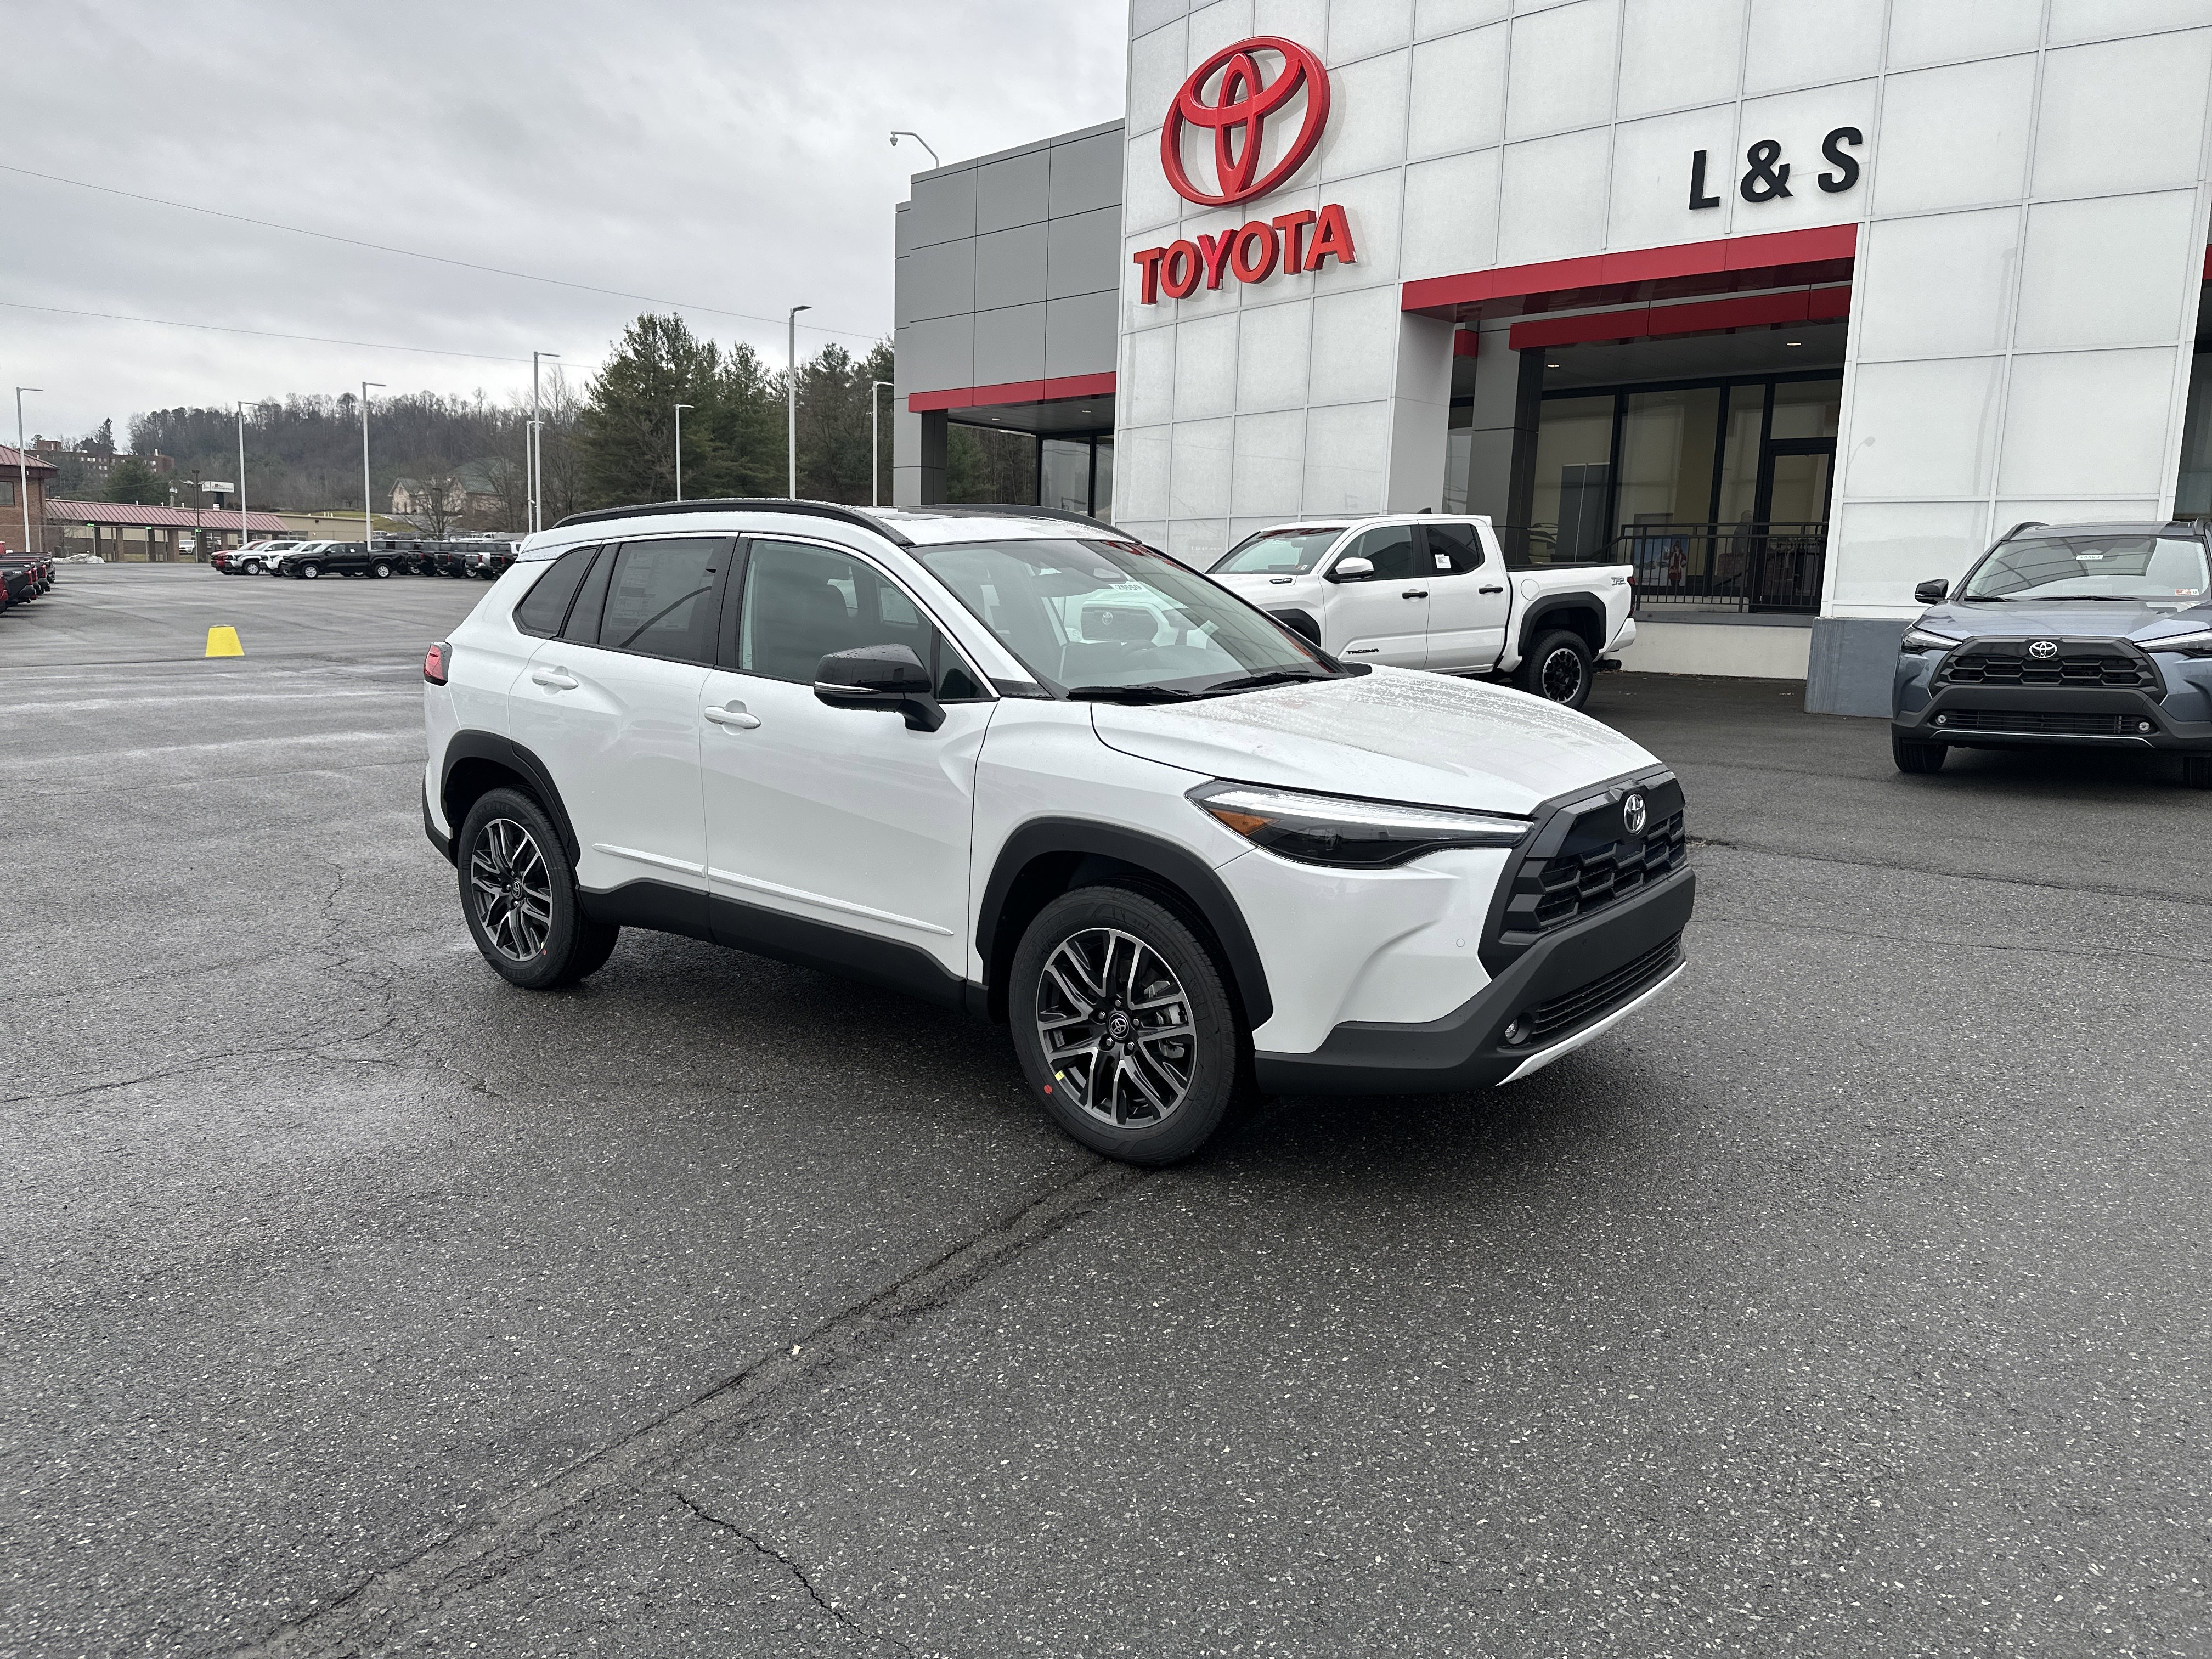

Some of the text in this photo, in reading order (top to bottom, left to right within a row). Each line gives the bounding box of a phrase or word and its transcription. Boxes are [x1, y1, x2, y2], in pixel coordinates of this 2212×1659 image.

[1689, 127, 1863, 210] L & S
[1133, 204, 1358, 305] TOYOTA
